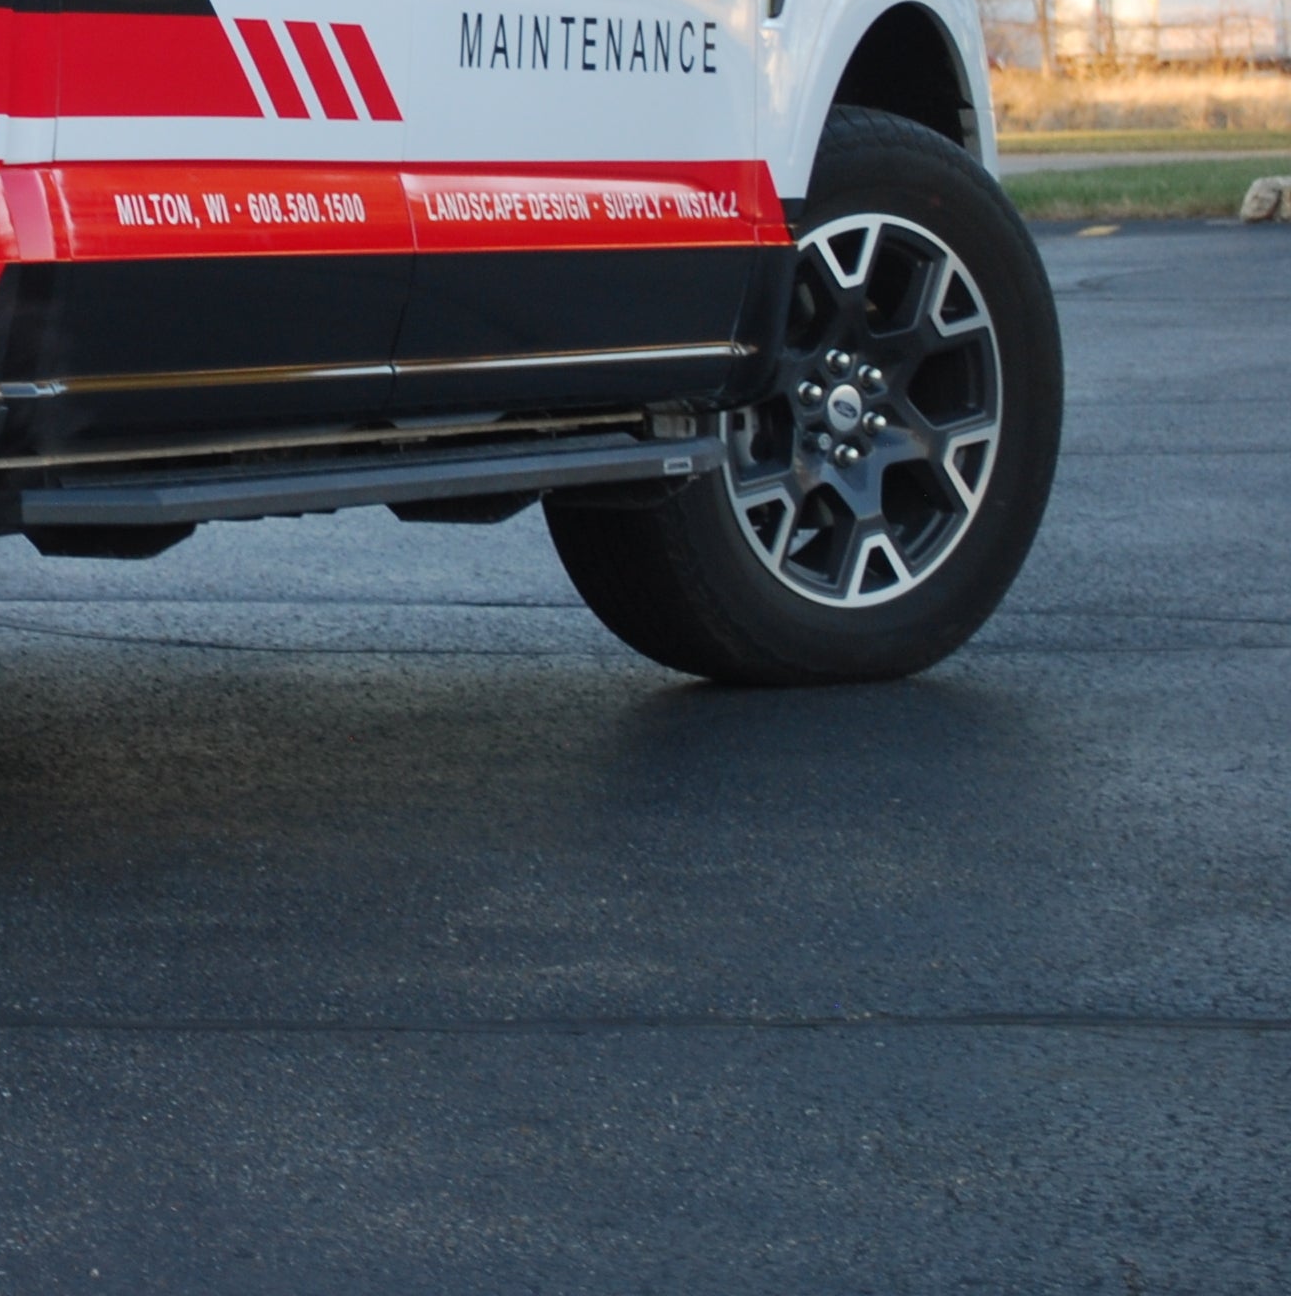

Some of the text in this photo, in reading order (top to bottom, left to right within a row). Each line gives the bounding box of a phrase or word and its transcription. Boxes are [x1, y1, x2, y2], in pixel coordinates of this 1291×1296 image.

[459, 12, 717, 74] MAINTENANCE
[114, 192, 367, 229] MILTON, WI 608.580.1500
[422, 190, 739, 221] LANDSCAPE DESIGN SUPPLY INSTALL
